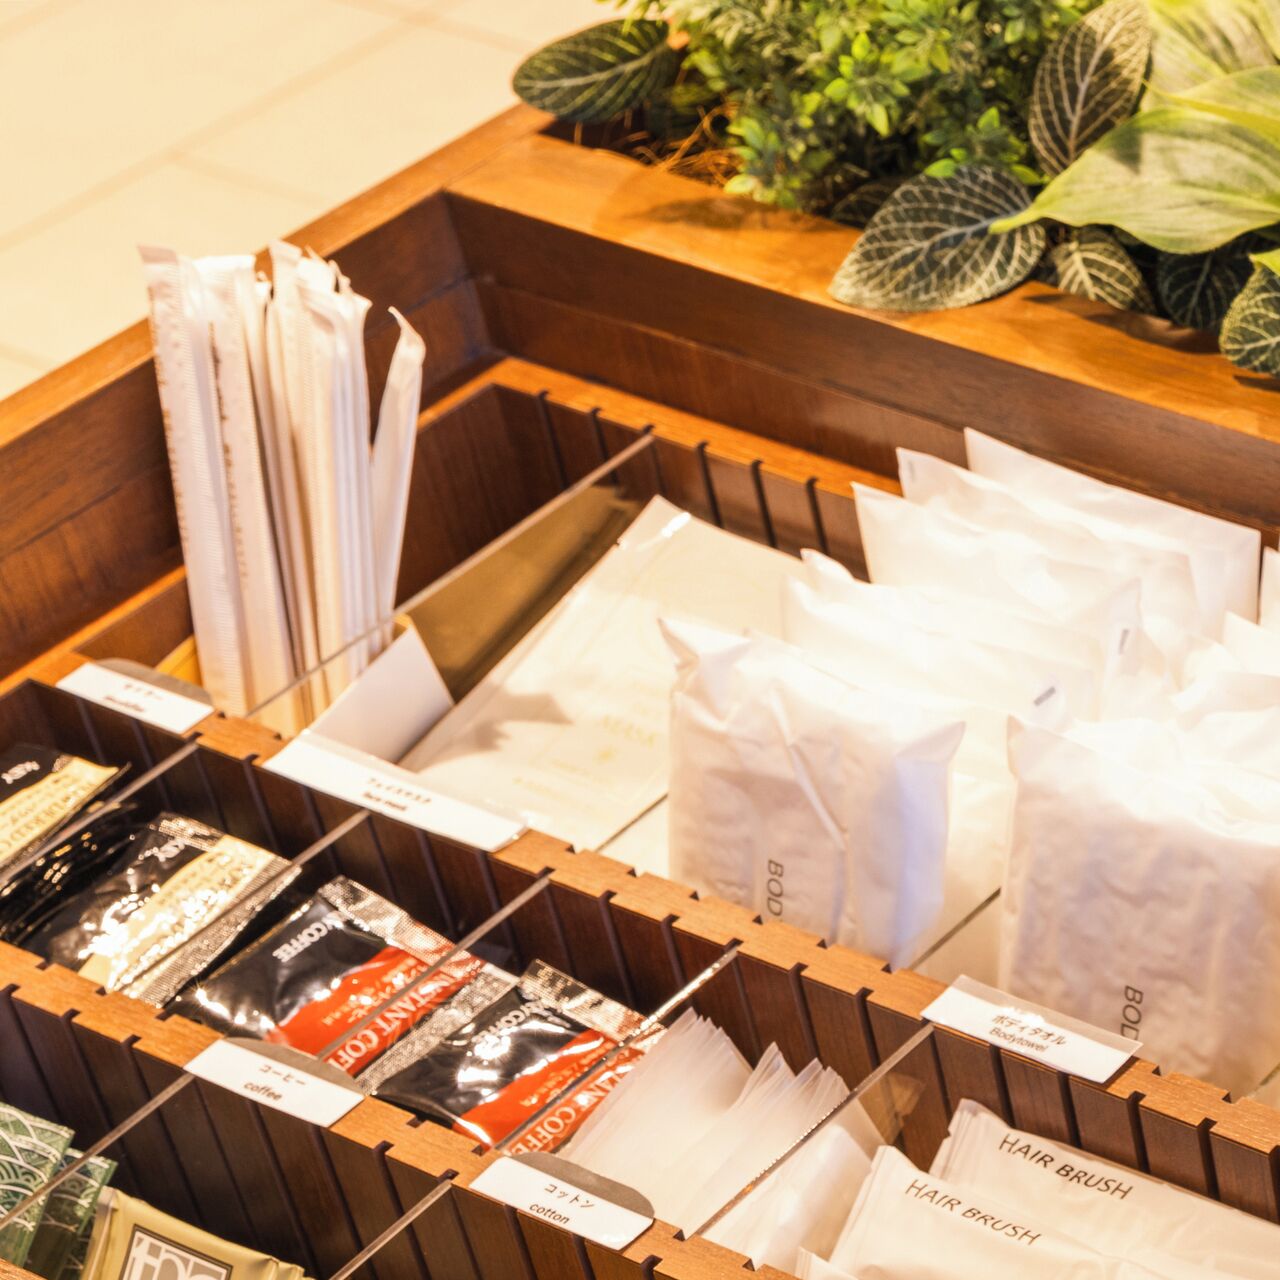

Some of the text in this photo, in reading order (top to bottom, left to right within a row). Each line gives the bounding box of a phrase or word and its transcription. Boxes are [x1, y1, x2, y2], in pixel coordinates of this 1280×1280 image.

[767, 859, 784, 919] BOD
[272, 922, 328, 963] COFFEE
[244, 1080, 283, 1103] coffee
[258, 1064, 307, 1087] コーヒー
[504, 1105, 577, 1157] COFFE
[999, 1134, 1133, 1200] HAIR BRUSH
[529, 1203, 571, 1225] cotton
[544, 1183, 595, 1208] コットン
[905, 1179, 1042, 1245] HAIR BRUSH
